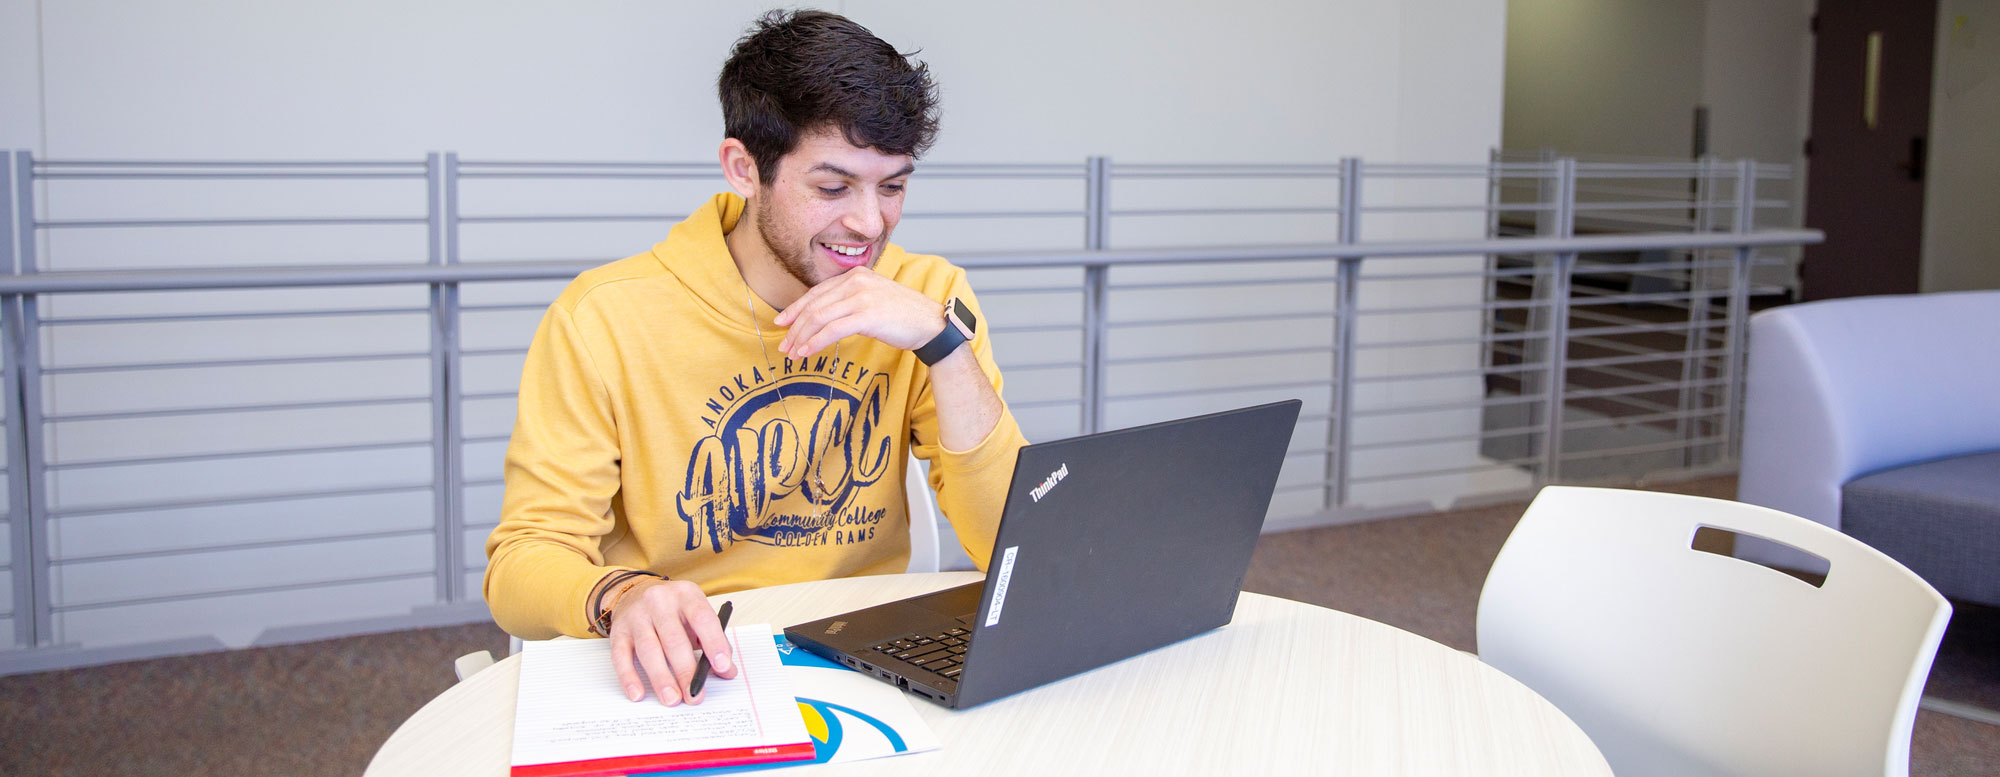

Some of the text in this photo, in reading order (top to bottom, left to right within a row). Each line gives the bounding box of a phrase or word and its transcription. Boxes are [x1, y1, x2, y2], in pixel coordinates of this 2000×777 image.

[701, 356, 869, 429] ANOKA-RAMSEY
[1029, 463, 1069, 503] ThinkPad
[763, 505, 886, 531] Community College
[775, 527, 875, 547] GOLDEN RAMS
